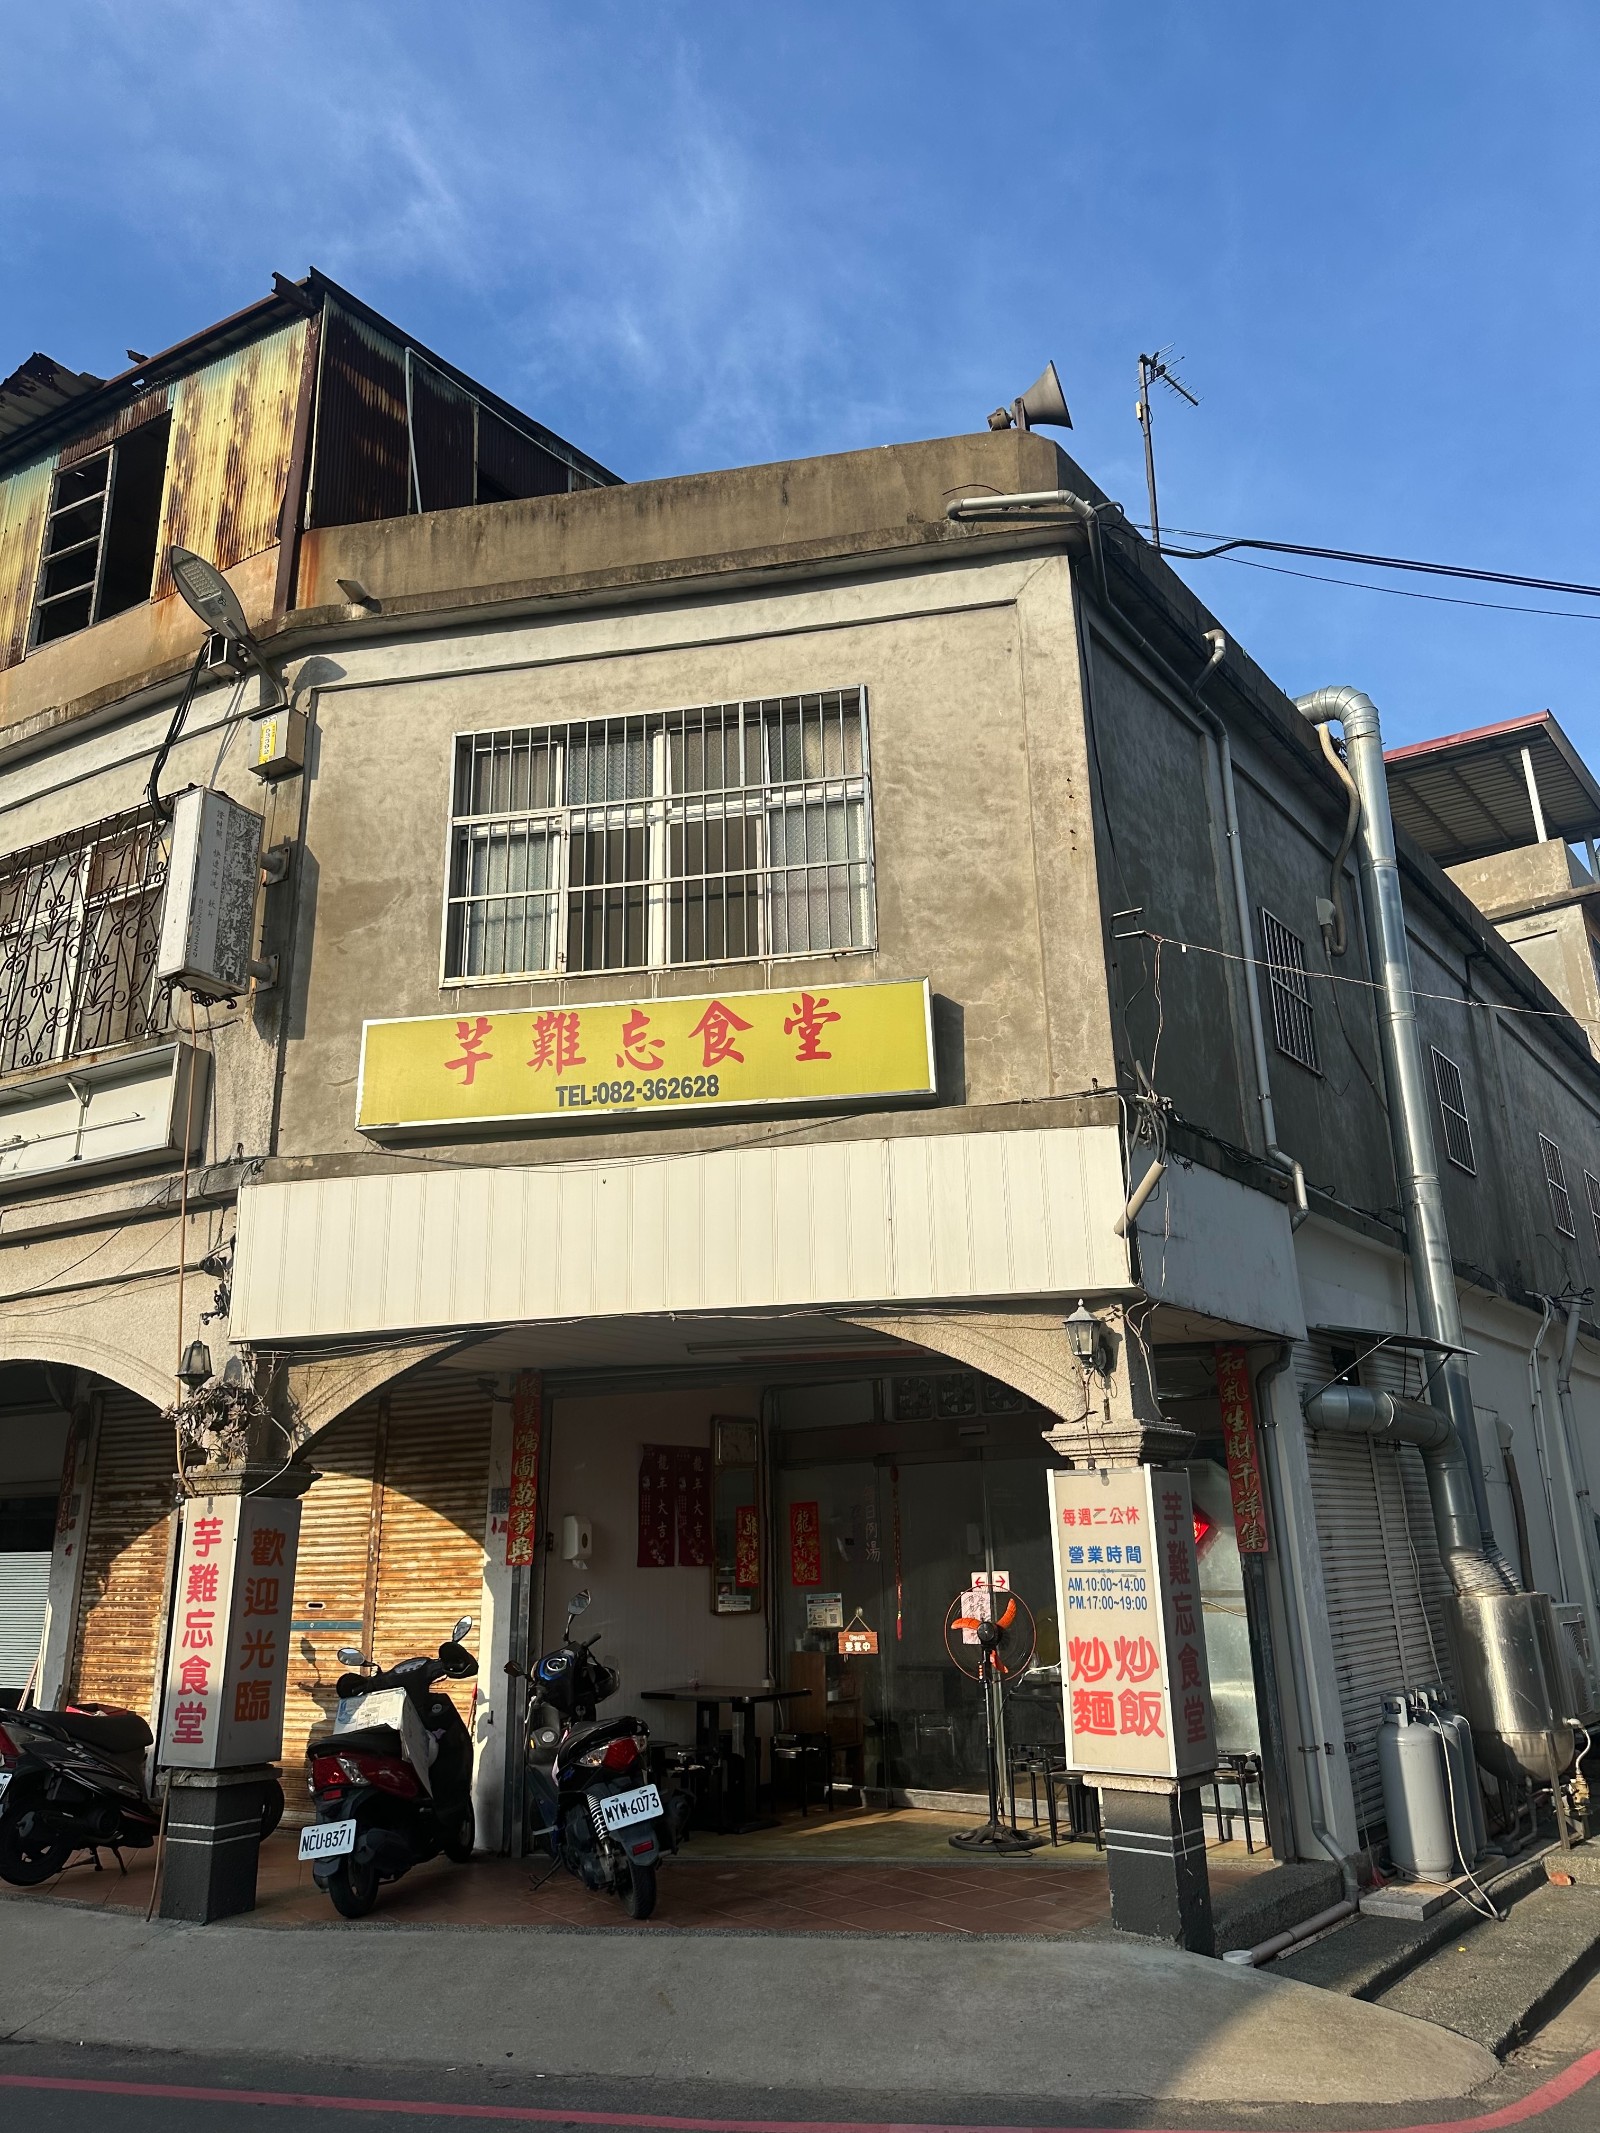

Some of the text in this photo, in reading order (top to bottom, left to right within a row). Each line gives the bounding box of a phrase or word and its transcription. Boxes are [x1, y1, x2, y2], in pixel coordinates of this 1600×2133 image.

[444, 992, 841, 1086] 芋難忘食堂
[555, 1074, 719, 1107] TEL:082-362628
[657, 1453, 669, 1538] 龍年大吉
[1062, 1506, 1140, 1526] 每週二公休
[1068, 1545, 1142, 1564] 營業時間
[172, 1516, 223, 1745] 芋難忘食堂
[234, 1527, 287, 1722] 歡迎光臨
[1161, 1490, 1207, 1745] 芋難忘食堂
[301, 1828, 352, 1852] NCU-8371
